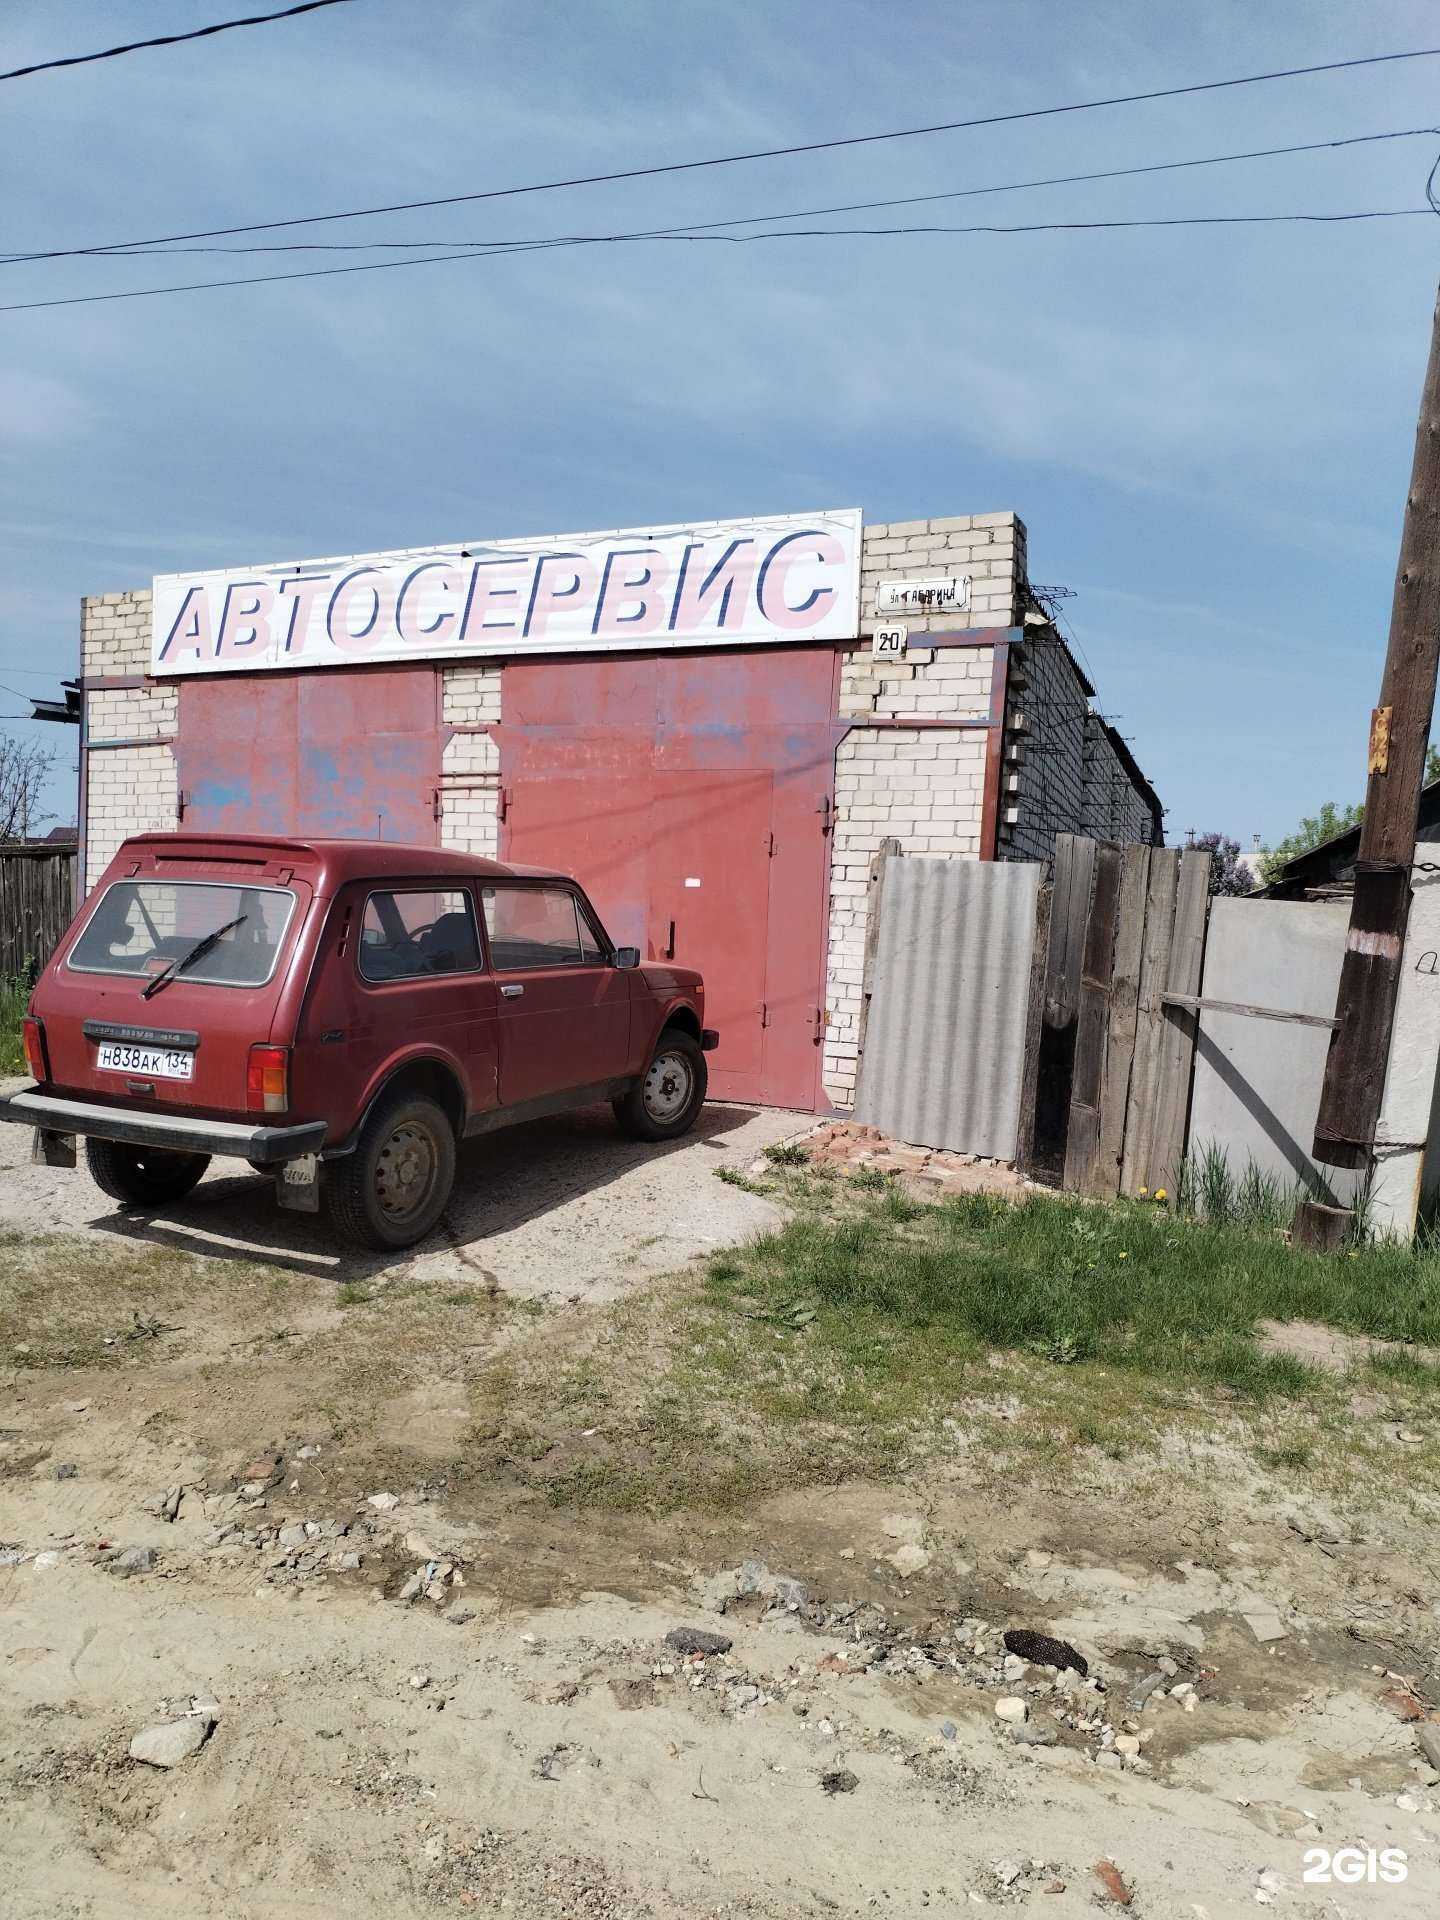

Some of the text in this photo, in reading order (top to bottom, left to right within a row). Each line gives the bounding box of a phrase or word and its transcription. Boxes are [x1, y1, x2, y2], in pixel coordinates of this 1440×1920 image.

[158, 530, 846, 663] АВТОСЕРВИС
[879, 632, 900, 651] 20
[165, 1052, 188, 1070] 134
